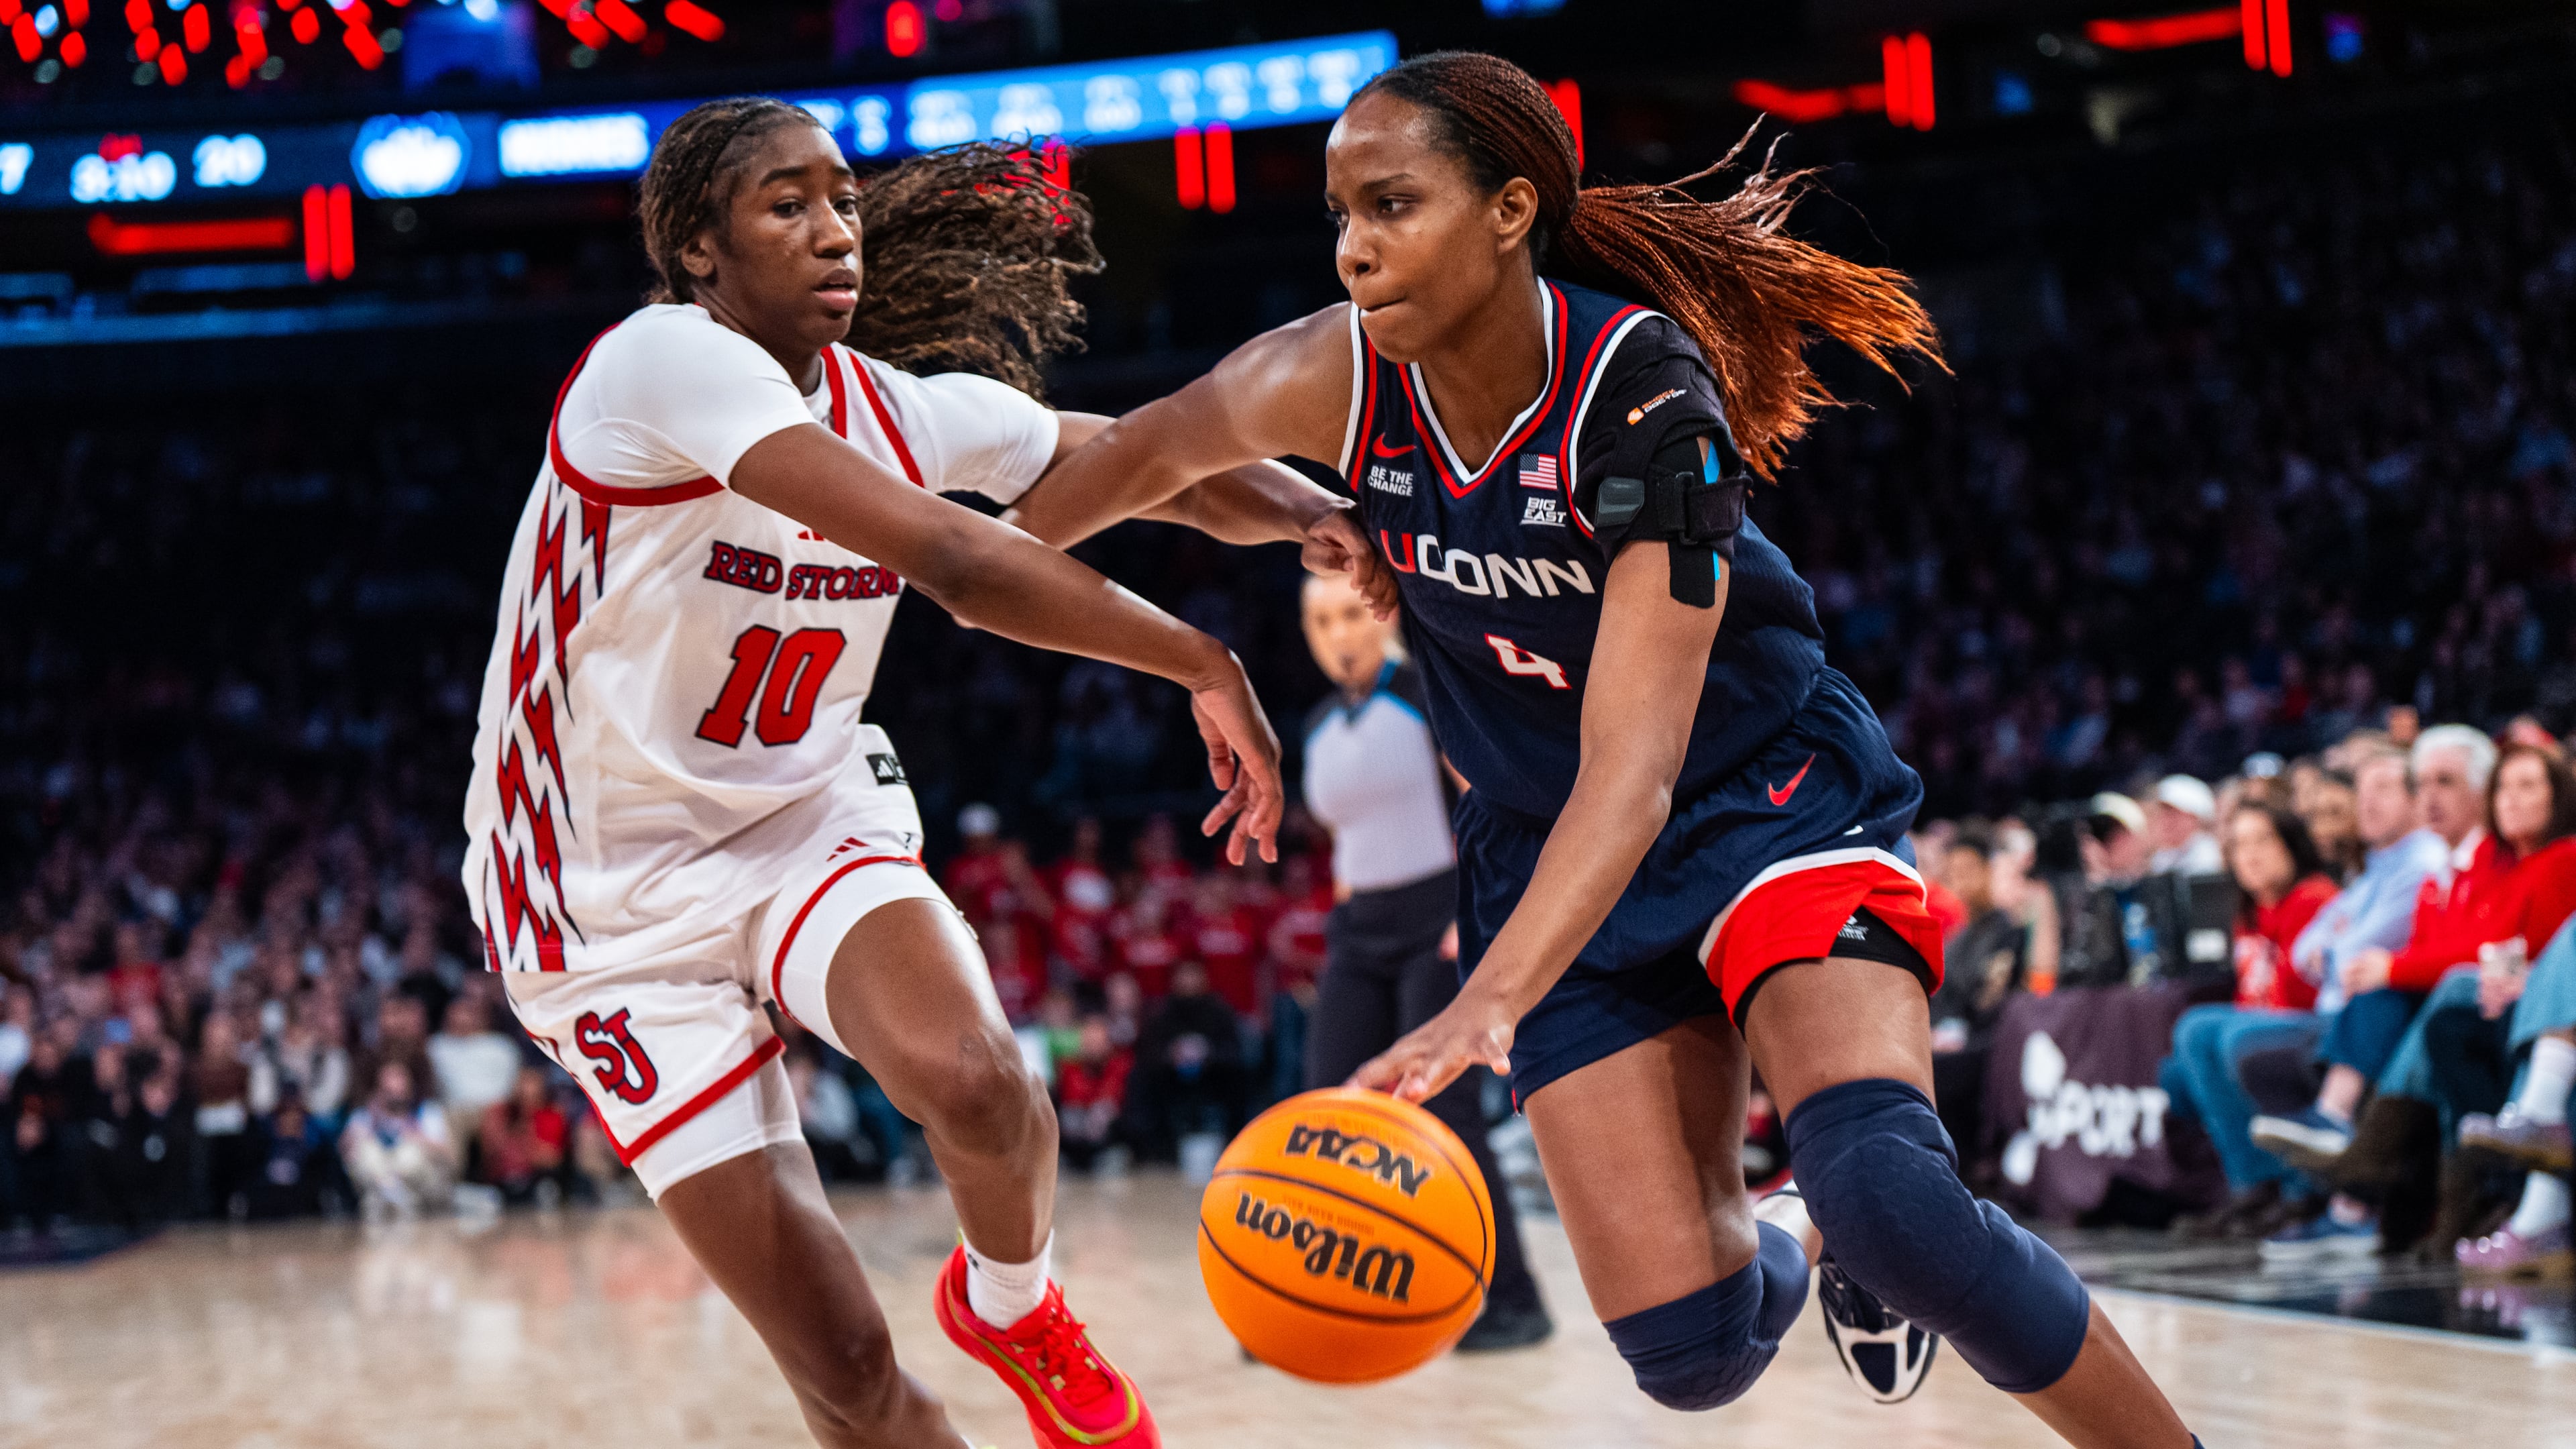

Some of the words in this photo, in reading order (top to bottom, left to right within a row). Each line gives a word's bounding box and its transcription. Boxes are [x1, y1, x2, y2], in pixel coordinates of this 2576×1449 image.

[1367, 475, 1413, 496] CHANGE
[1371, 465, 1387, 480] BE
[1389, 470, 1413, 486] THE
[1527, 496, 1556, 511] BIG
[1523, 508, 1567, 523] EAST
[703, 540, 784, 594] RED
[785, 563, 903, 601] STORM
[1380, 529, 1596, 599] UCONN
[695, 624, 847, 749] 10
[1485, 633, 1572, 690] 4
[1284, 1123, 1432, 1198] NCAA
[1234, 1191, 1415, 1303] Wilson
